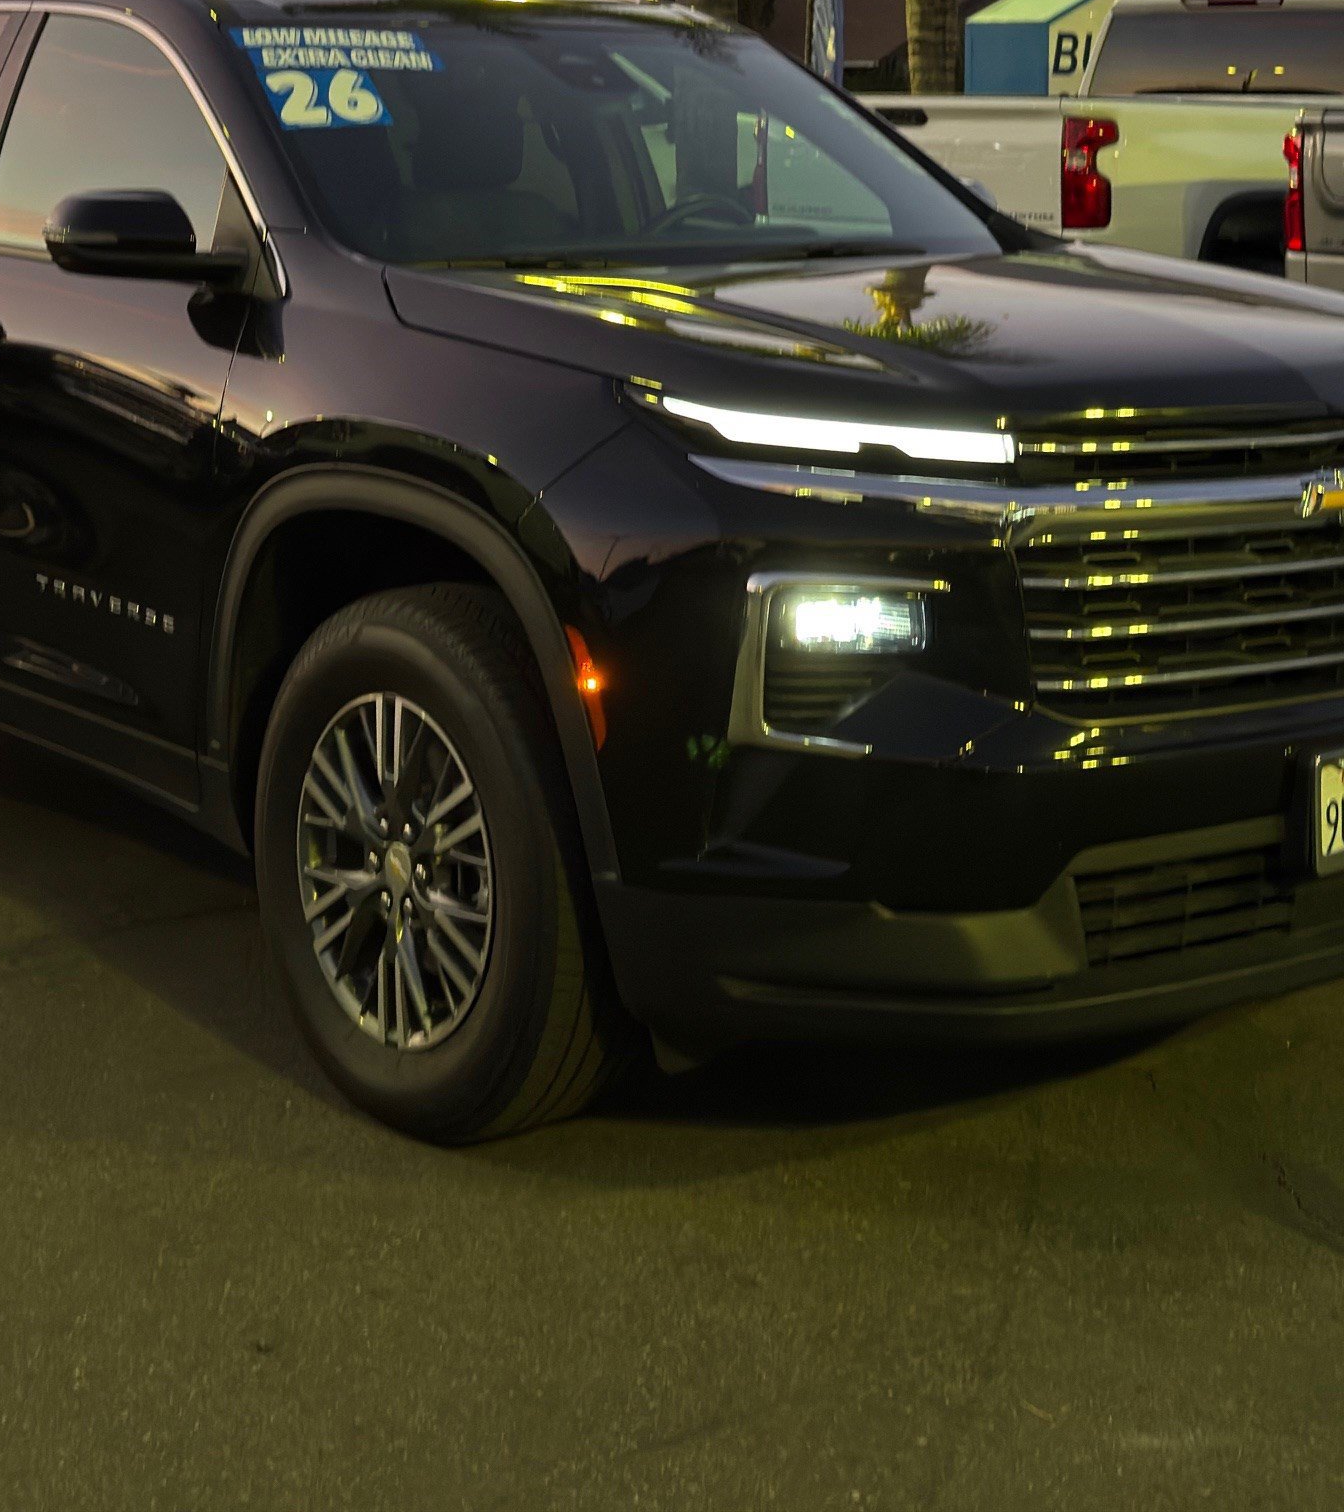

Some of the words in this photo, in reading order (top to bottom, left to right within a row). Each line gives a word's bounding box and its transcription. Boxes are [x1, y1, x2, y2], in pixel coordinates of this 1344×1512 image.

[242, 27, 301, 47] LOW
[303, 27, 416, 50] MILEAGE
[261, 47, 351, 69] EXTRA
[350, 47, 433, 72] CLEAN
[265, 68, 383, 127] 26
